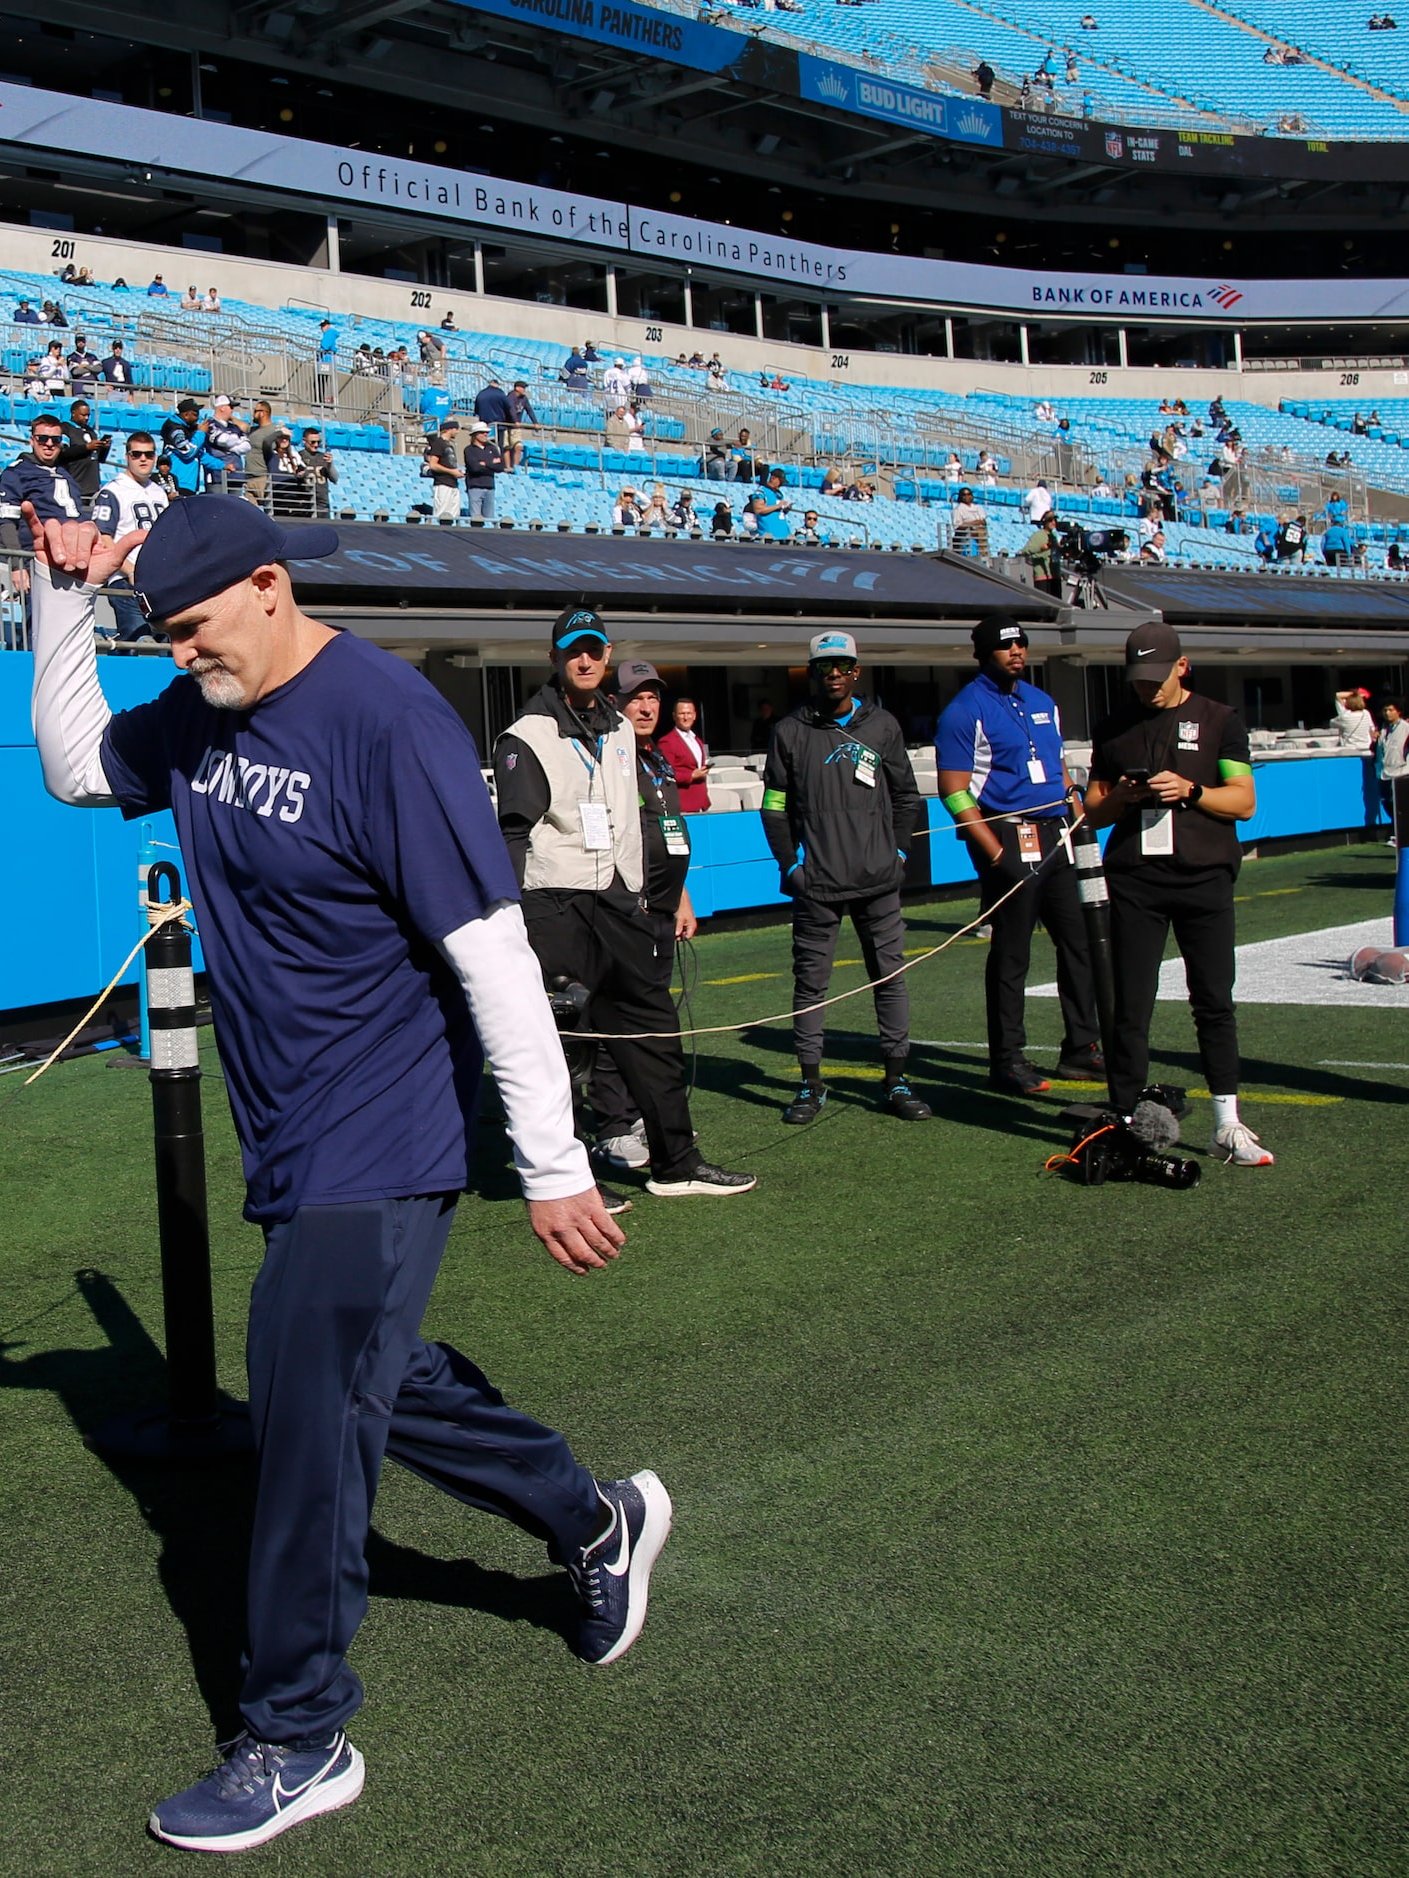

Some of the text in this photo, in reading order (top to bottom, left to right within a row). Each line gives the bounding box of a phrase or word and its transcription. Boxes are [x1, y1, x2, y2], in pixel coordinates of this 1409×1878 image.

[600, 6, 683, 52] PANTHERS
[861, 83, 942, 124] BUD LIGHT
[1009, 110, 1027, 121] TEXT
[1028, 113, 1048, 126] YOUR
[1048, 117, 1084, 131] CONCERN
[1026, 125, 1075, 140] LOCATION TO
[1178, 132, 1235, 146] TEAM TACKLING
[1106, 141, 1123, 157] NFL
[1127, 136, 1159, 149] IN-GAME
[1307, 141, 1329, 153] TOTAL
[1132, 151, 1156, 162] STATS
[1178, 145, 1194, 157] DAL
[338, 161, 847, 281] Official Bank of the Carolina Panthers
[51, 238, 76, 260] 201
[410, 290, 432, 310] 202
[1032, 287, 1203, 307] BANK OF AMERICA
[645, 326, 663, 343] 203
[831, 355, 850, 370] 204
[1088, 371, 1108, 385] 205
[1340, 374, 1359, 386] 206
[52, 478, 81, 518] 4
[344, 549, 450, 573] OF
[468, 554, 797, 587] AMERICA
